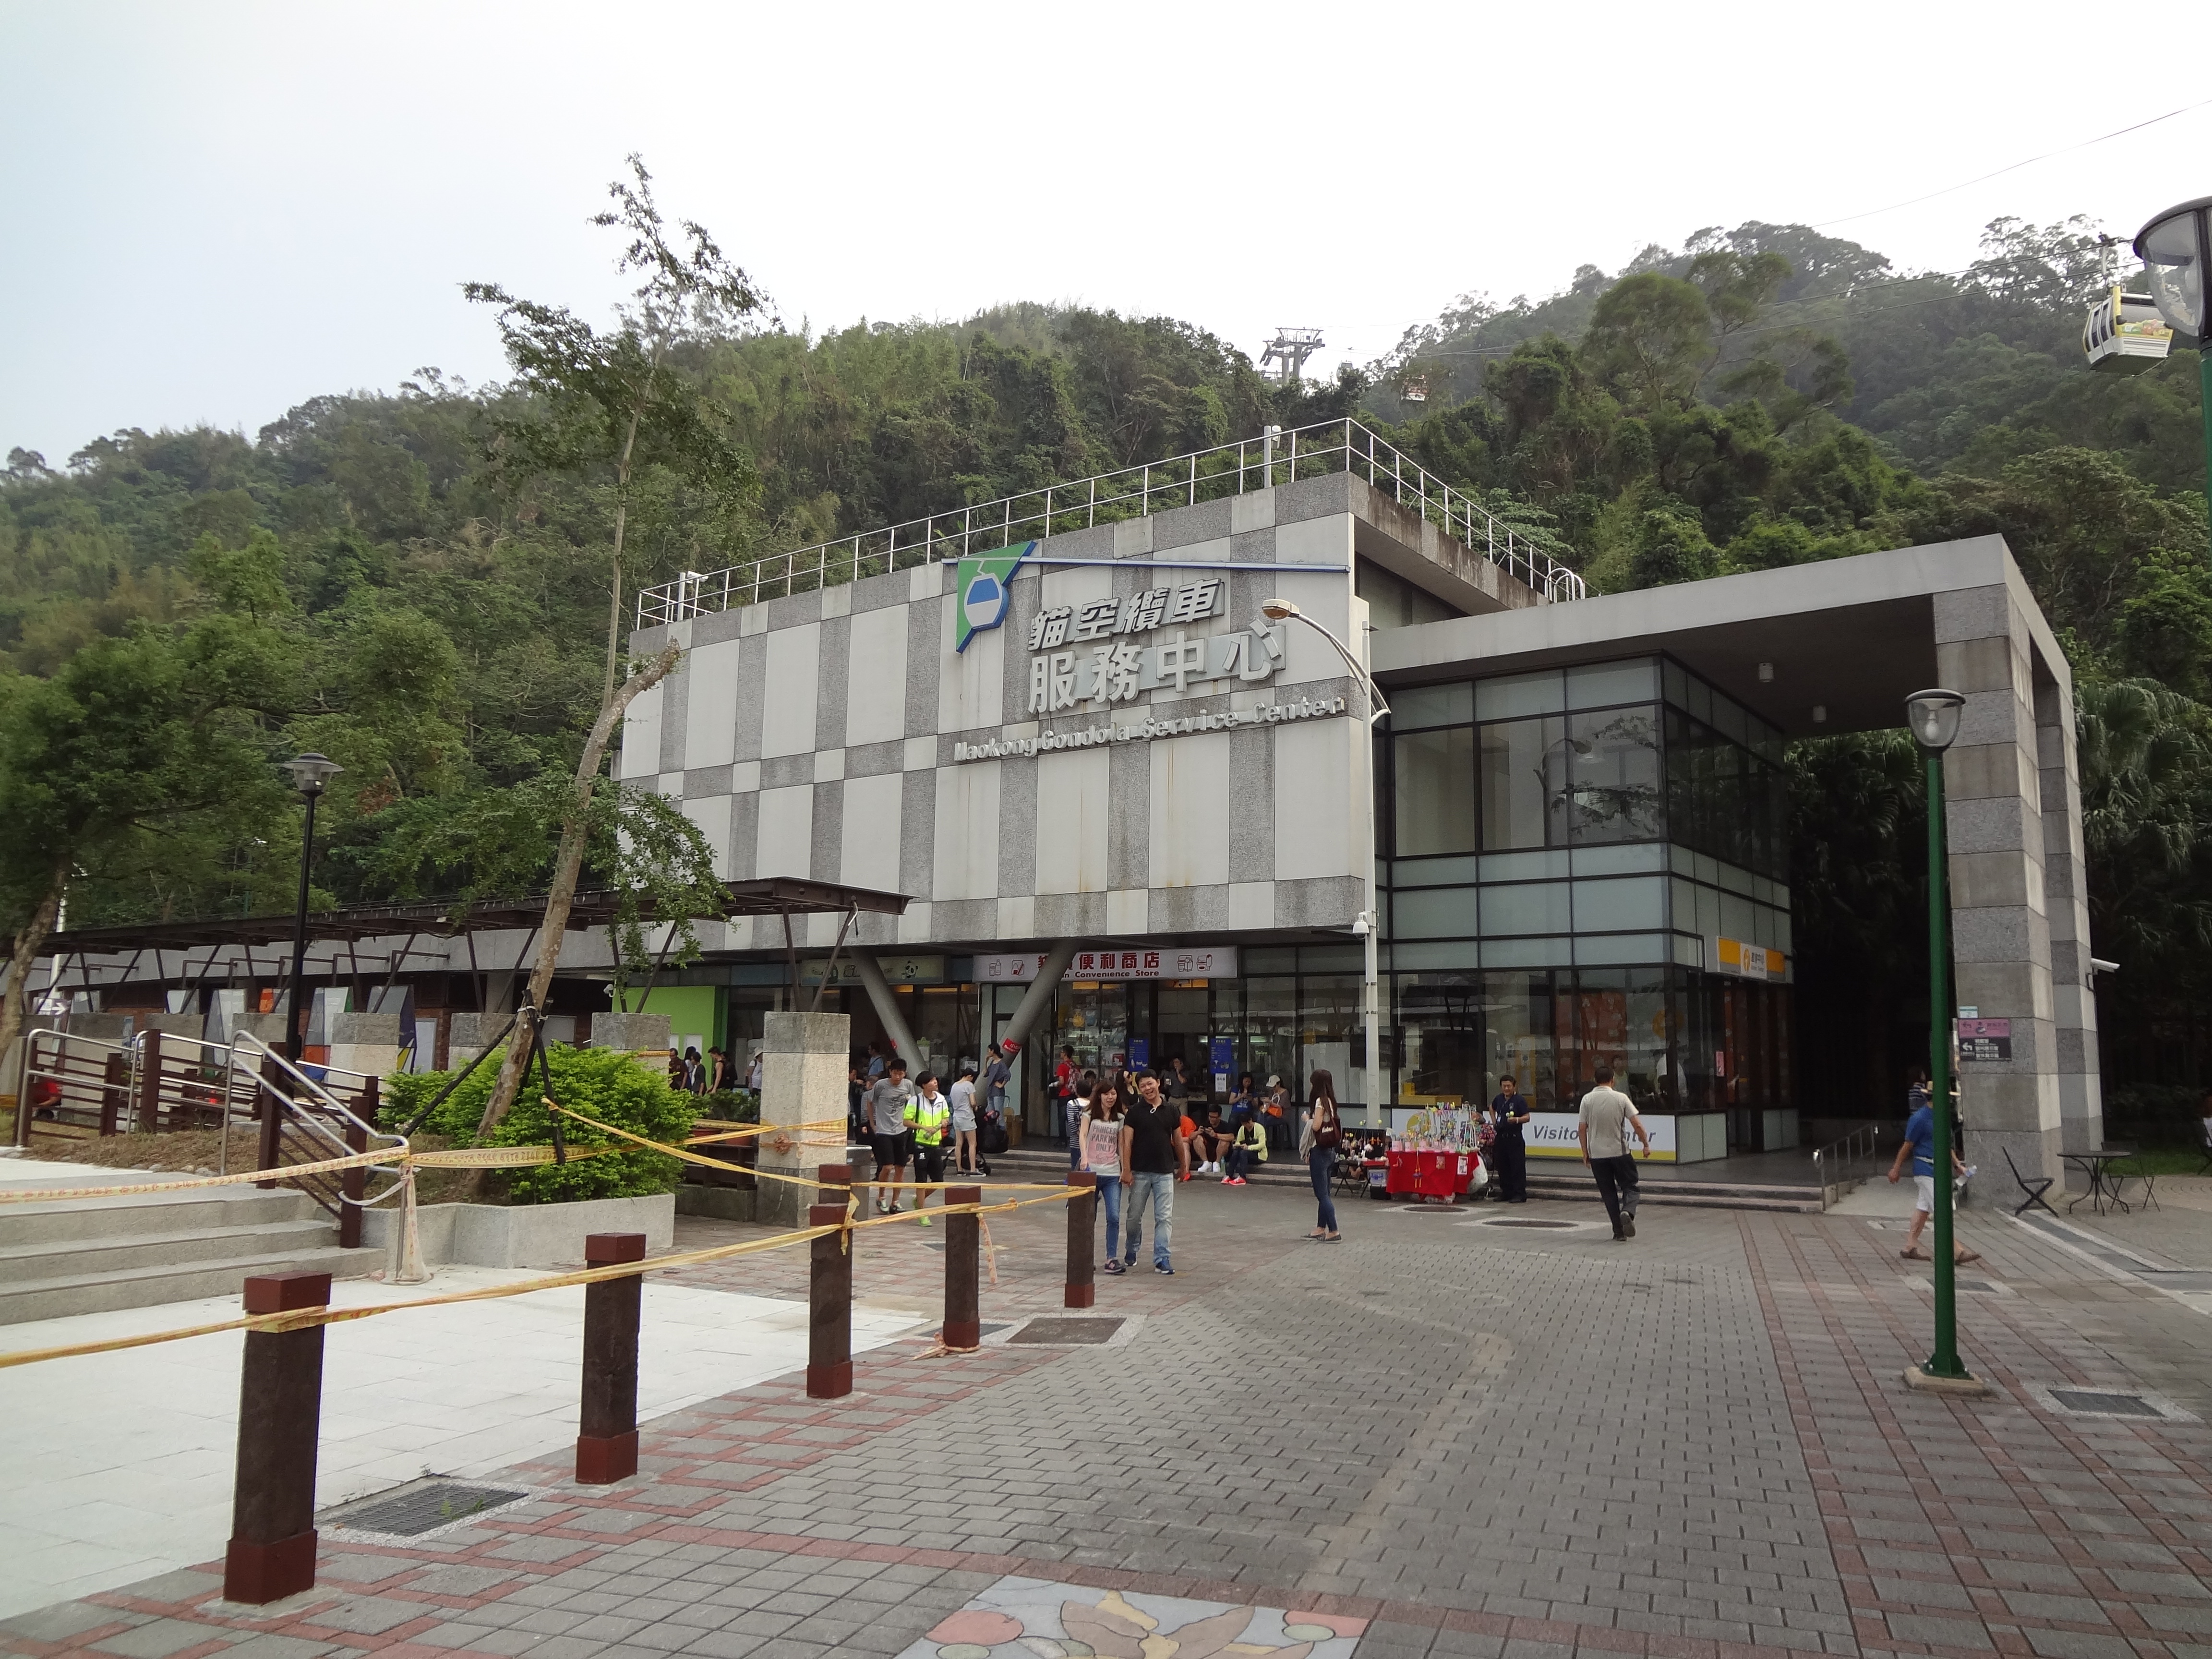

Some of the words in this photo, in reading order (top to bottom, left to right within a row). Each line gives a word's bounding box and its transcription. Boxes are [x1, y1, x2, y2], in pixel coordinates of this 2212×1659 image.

[1028, 577, 1221, 651] 貓空纜車
[1028, 619, 1281, 714] 服務中心
[954, 737, 1038, 761] Maokong
[1041, 721, 1130, 750] Gondola
[1141, 709, 1239, 739] Service
[1252, 696, 1345, 723] Center
[1038, 952, 1159, 970] 便利商店
[1093, 1125, 1118, 1135] PRINCES
[1533, 1125, 1579, 1141] Visito
[1091, 1133, 1117, 1145] PARKING
[1096, 1143, 1112, 1152] ONLY
